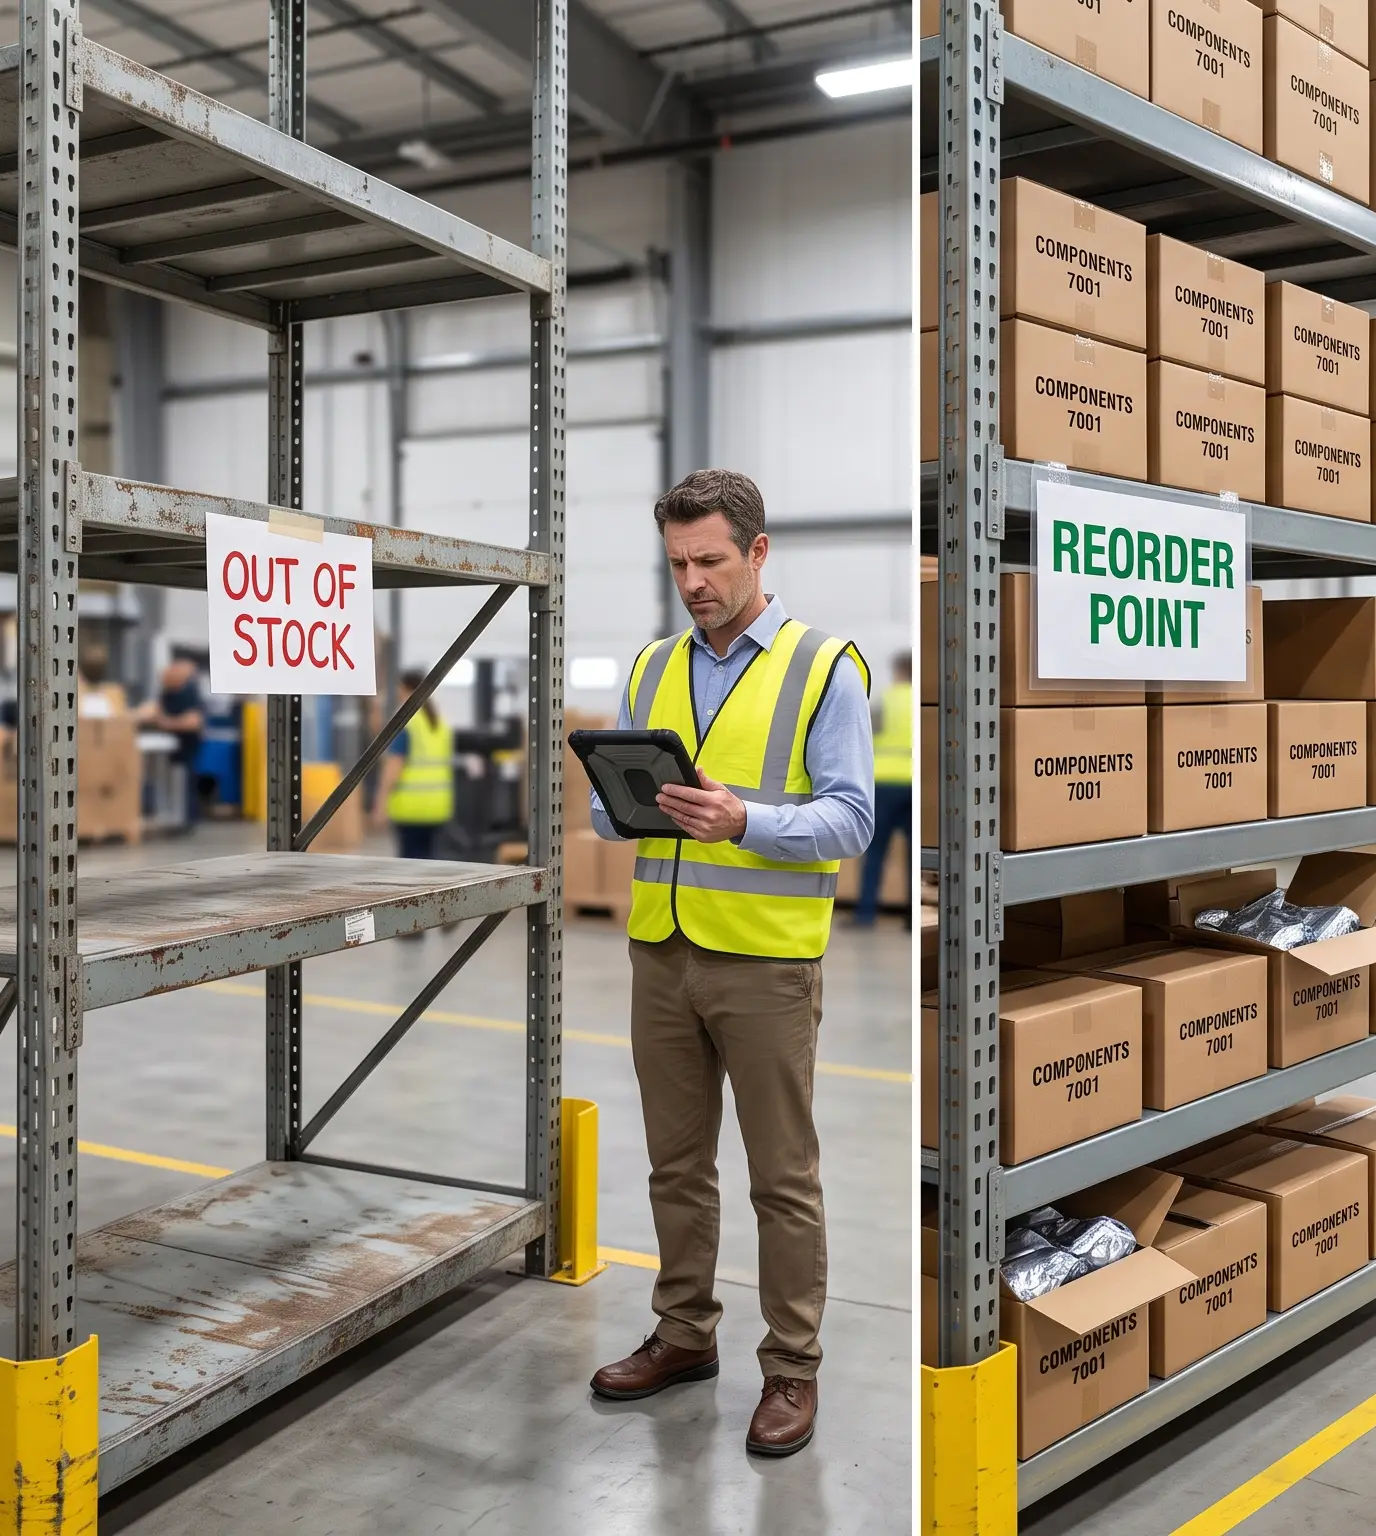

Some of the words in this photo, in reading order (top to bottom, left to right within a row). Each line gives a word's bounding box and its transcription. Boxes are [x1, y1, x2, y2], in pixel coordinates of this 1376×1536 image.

[1168, 9, 1251, 68] COMPONENTS
[1195, 49, 1225, 79] 7001
[1290, 75, 1360, 125] COMPONENTS
[1313, 109, 1338, 136] 7001
[1035, 235, 1133, 282] COMPONENTS
[1067, 271, 1101, 298] 7001
[1175, 285, 1254, 325] COMPONENTS
[1200, 317, 1228, 340] 7001
[1294, 325, 1360, 361] COMPONENTS
[1316, 354, 1339, 376] 7001
[1035, 375, 1133, 414] COMPONENTS
[1067, 409, 1101, 433] 7001
[1175, 410, 1255, 443] COMPONENTS
[1201, 440, 1229, 461] 7001
[1294, 439, 1361, 468] COMPONENTS
[1316, 466, 1340, 485] 7001
[1053, 520, 1234, 589] REORDER
[223, 551, 299, 605] OUT
[313, 563, 357, 609] OF
[1089, 593, 1205, 649] POINT
[233, 614, 355, 671] STOCK
[1177, 746, 1258, 769] COMPONENTS
[1289, 740, 1357, 760] COMPONENTS
[1034, 753, 1133, 778] COMPONENTS
[1311, 763, 1335, 780] 7001
[1067, 780, 1101, 802] 7001
[1204, 771, 1232, 790] 7001
[1293, 973, 1361, 1006] COMPONENTS
[1179, 1002, 1258, 1041] COMPONENTS
[1315, 999, 1338, 1021] 7001
[1206, 1032, 1233, 1057] 7001
[1032, 1041, 1130, 1087] COMPONENTS
[1066, 1075, 1099, 1102] 7001
[1292, 1202, 1360, 1248] COMPONENTS
[1315, 1233, 1338, 1257] 7001
[1179, 1253, 1258, 1304] COMPONENTS
[1205, 1288, 1233, 1315] 7001
[1039, 1313, 1137, 1373] COMPONENTS
[1071, 1352, 1105, 1385] 7001
